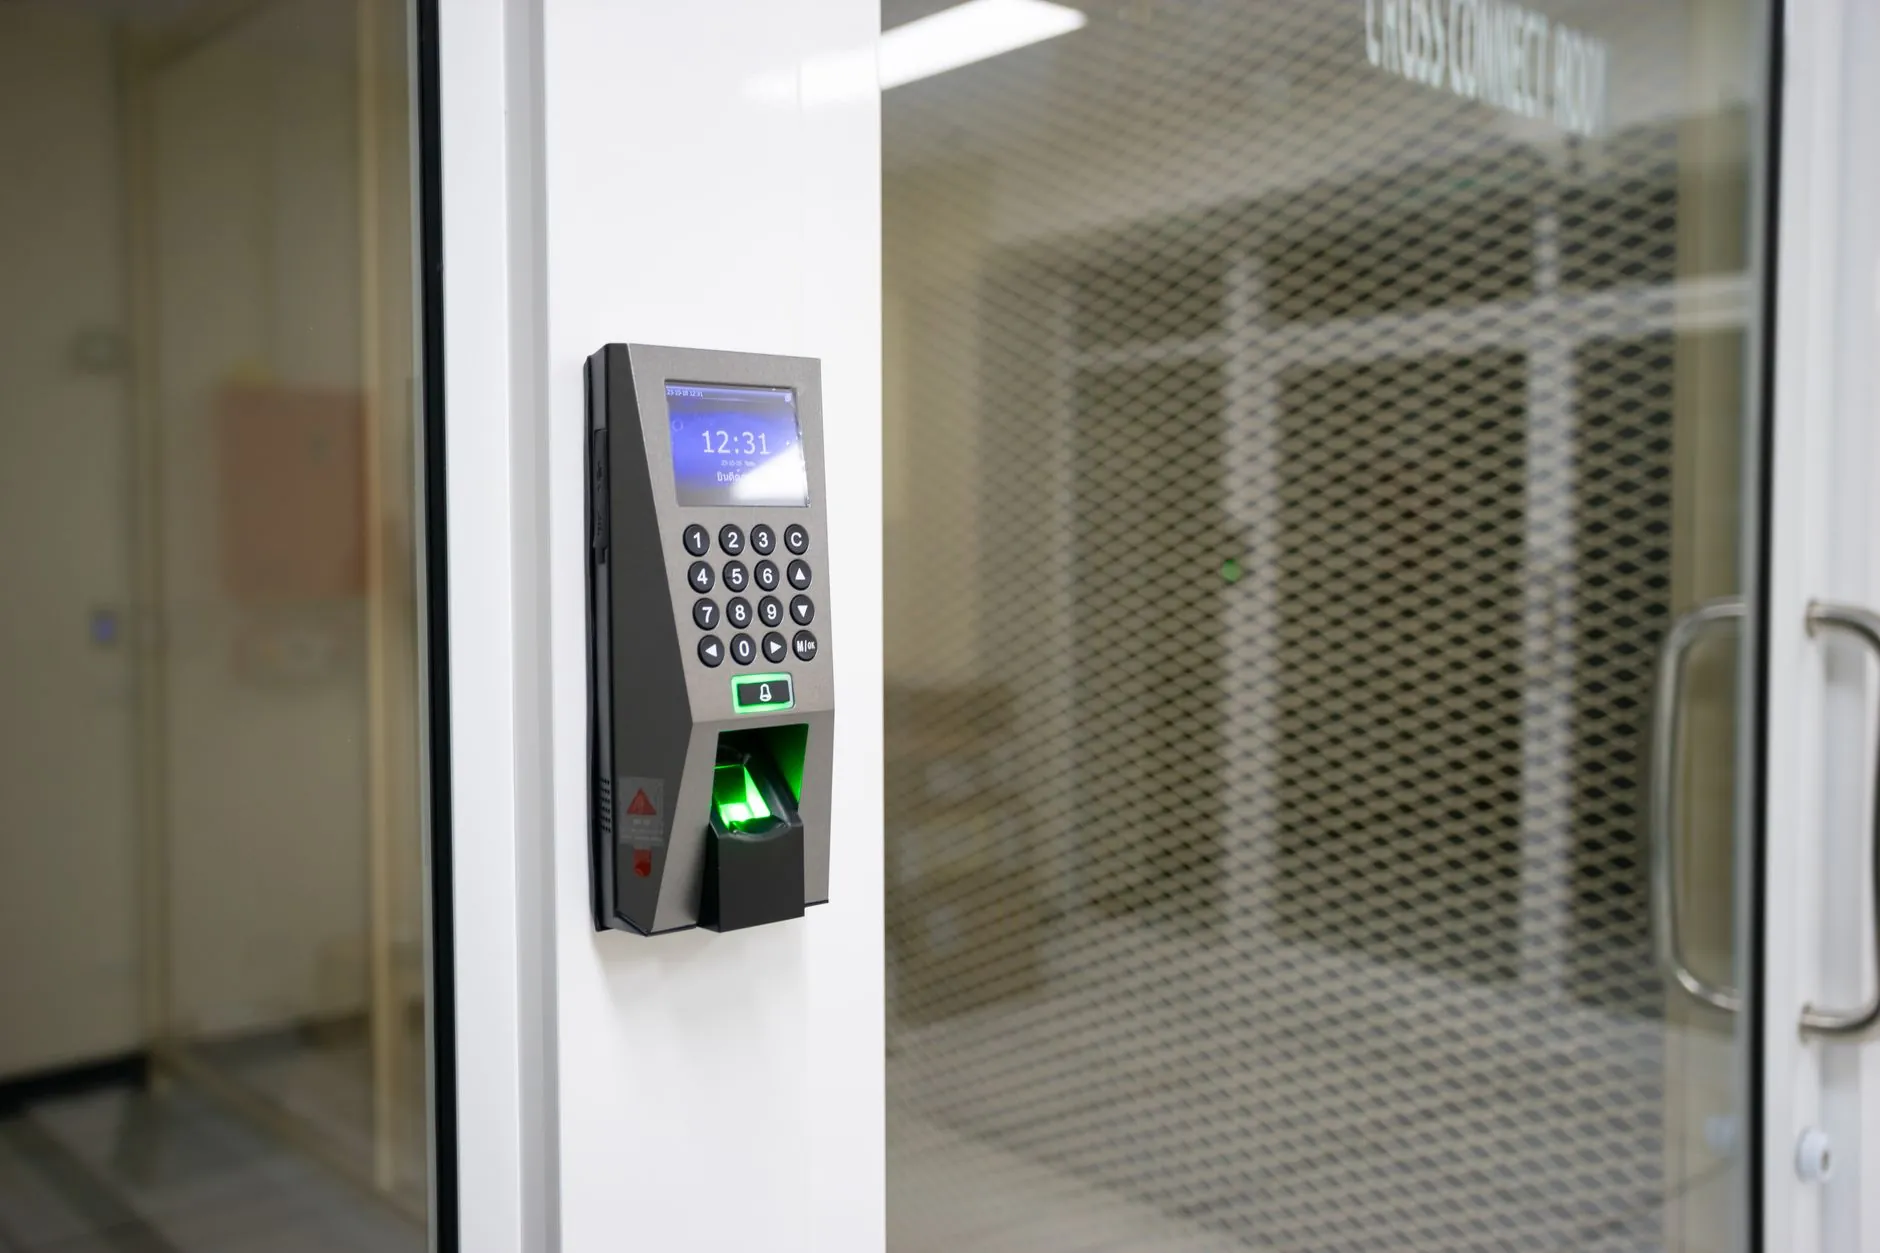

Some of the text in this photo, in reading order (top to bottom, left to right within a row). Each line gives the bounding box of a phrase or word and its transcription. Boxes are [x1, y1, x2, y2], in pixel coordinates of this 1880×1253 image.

[1449, 0, 1549, 118] CONNECT
[701, 430, 772, 455] 12:31
[694, 532, 802, 548] 1 2 3 C
[697, 568, 772, 584] 4 5 6
[702, 604, 776, 623] 7 8 9
[739, 641, 749, 657] 0
